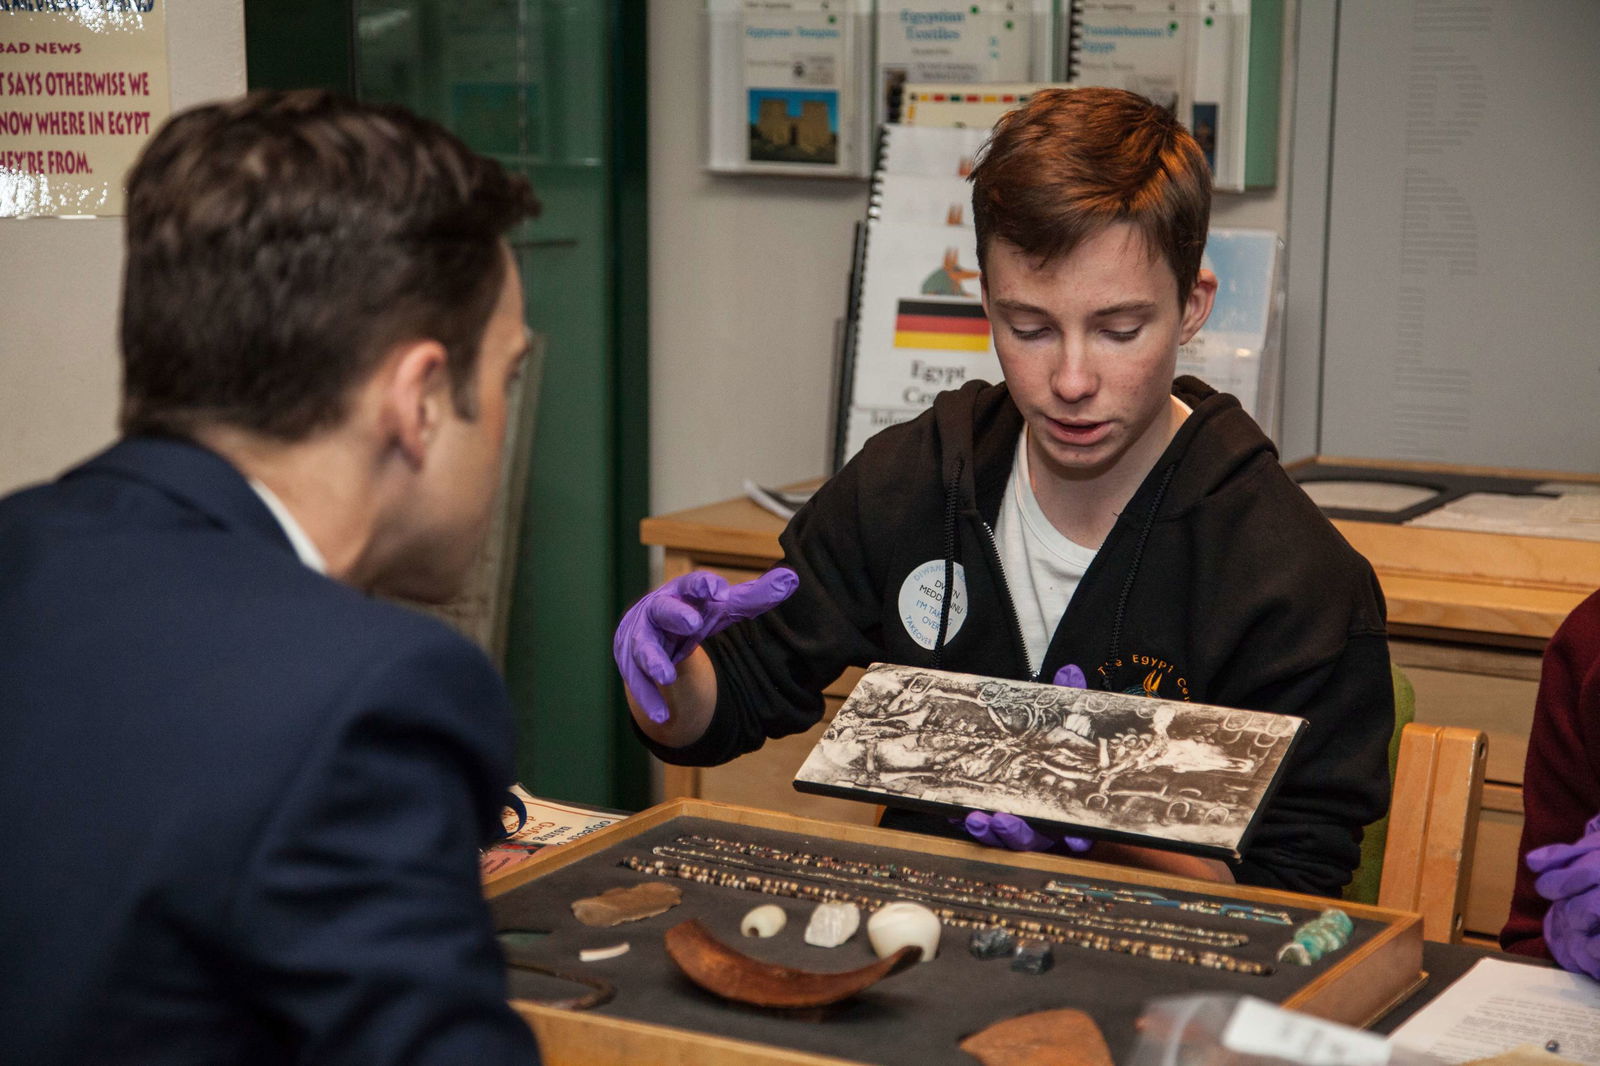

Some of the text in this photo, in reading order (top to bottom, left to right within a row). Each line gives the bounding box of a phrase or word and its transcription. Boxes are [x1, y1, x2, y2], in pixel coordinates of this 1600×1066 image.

[35, 42, 82, 54] NEWS
[7, 72, 42, 96] SAYS
[45, 72, 126, 96] OTHERWISE
[128, 72, 149, 96] WE
[35, 111, 85, 135] WHERE
[89, 112, 104, 135] IN
[108, 112, 151, 136] EGYPT
[48, 151, 93, 174] FROM.
[911, 359, 966, 384] Egypt
